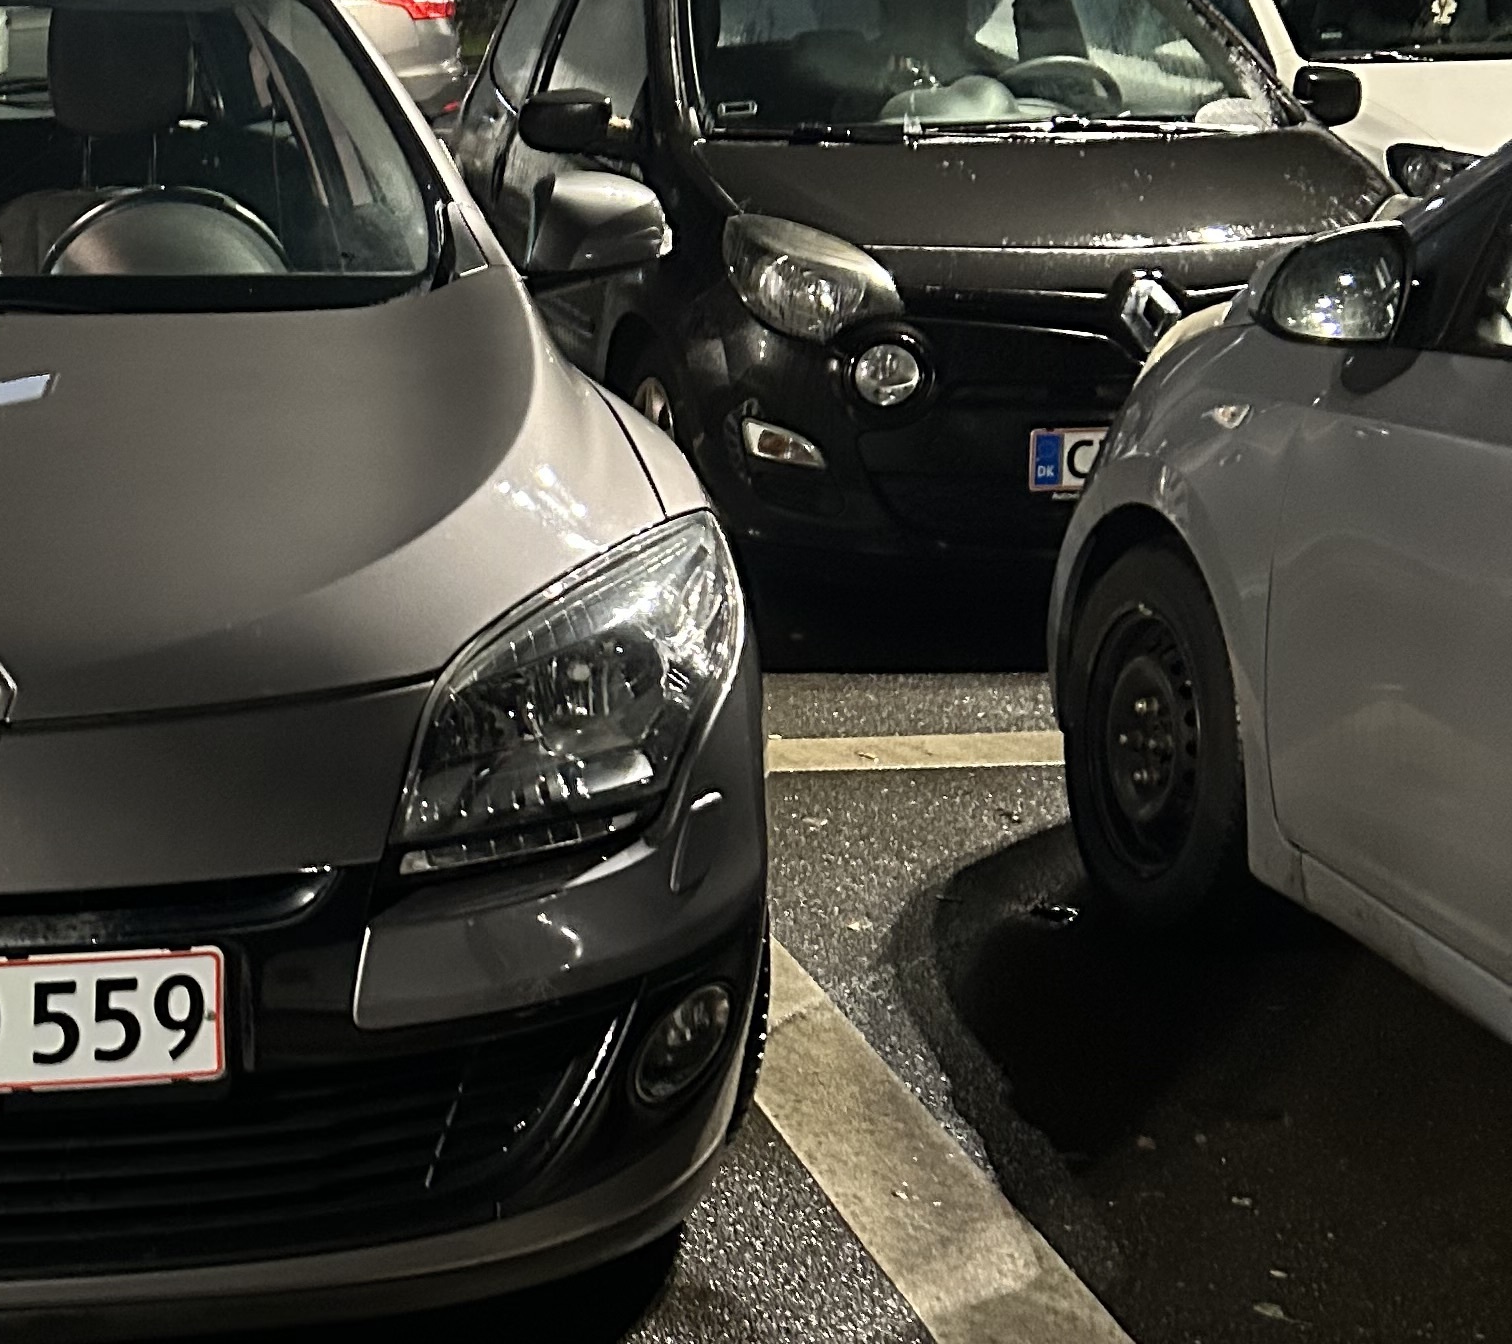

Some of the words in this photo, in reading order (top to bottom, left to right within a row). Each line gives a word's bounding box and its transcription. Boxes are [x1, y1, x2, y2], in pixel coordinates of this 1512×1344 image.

[1037, 465, 1055, 478] DK
[1066, 439, 1106, 479] C
[31, 972, 206, 1065] 559
